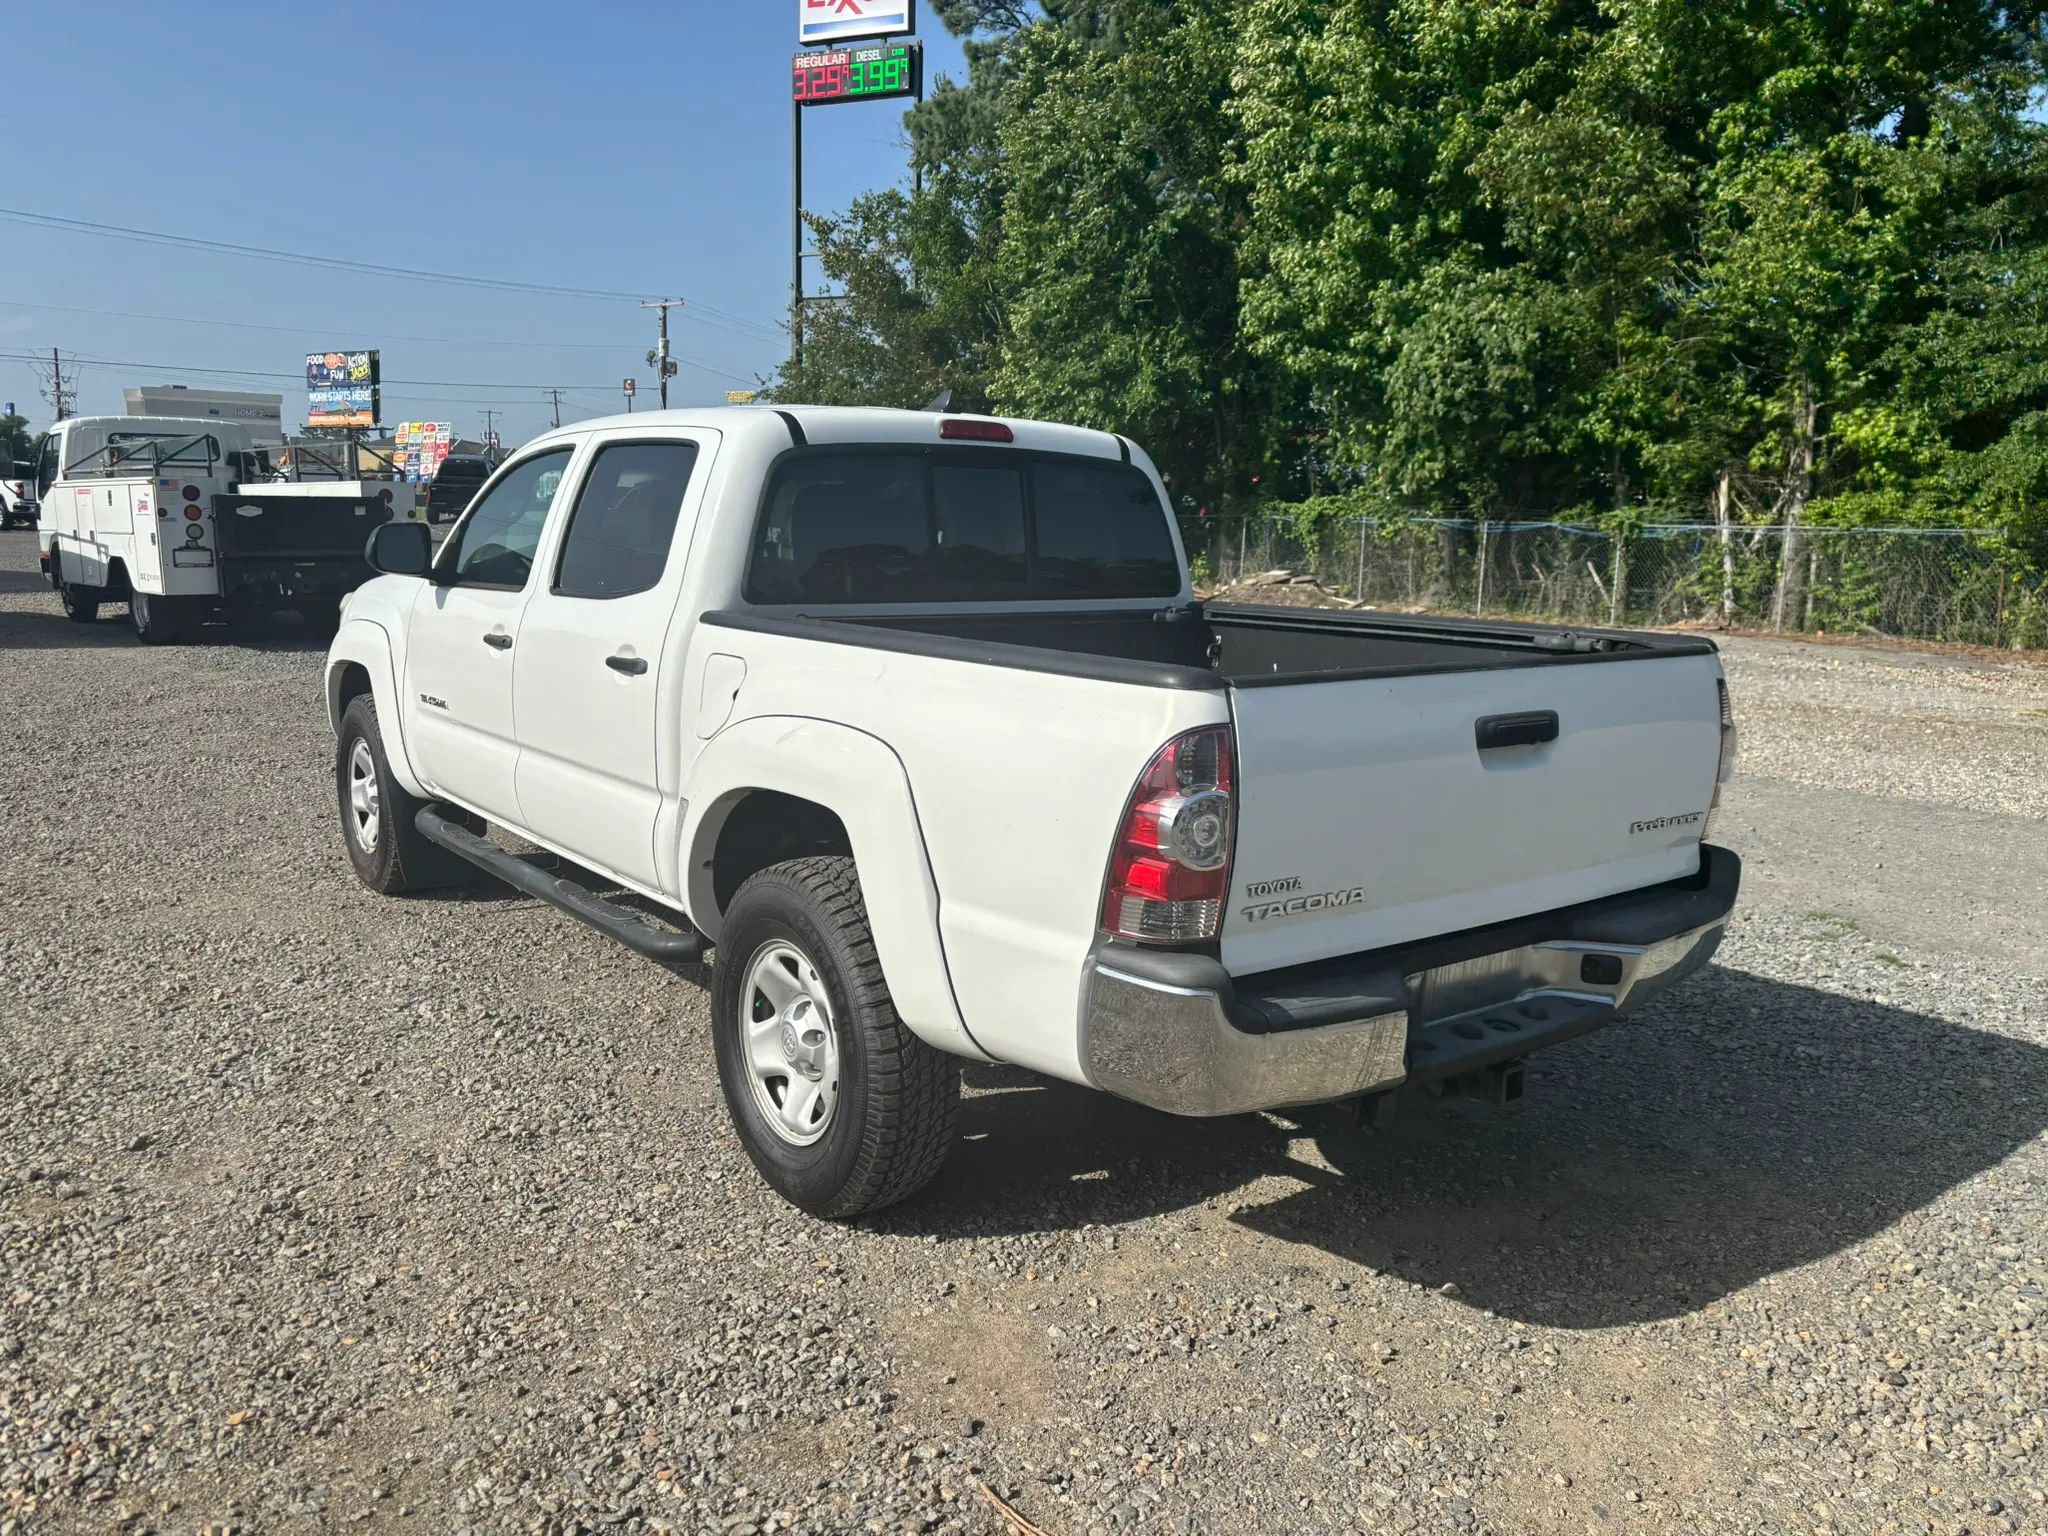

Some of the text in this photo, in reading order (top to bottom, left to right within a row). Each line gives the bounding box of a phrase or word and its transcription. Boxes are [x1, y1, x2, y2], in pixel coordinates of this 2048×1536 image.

[796, 53, 846, 68] REGULAR
[856, 49, 881, 62] DIESEL
[306, 354, 324, 366] FOOD
[330, 370, 344, 381] FUN
[328, 391, 351, 401] STARTS
[1246, 876, 1304, 898] TOYOTA
[1240, 887, 1366, 922] TACOMA
